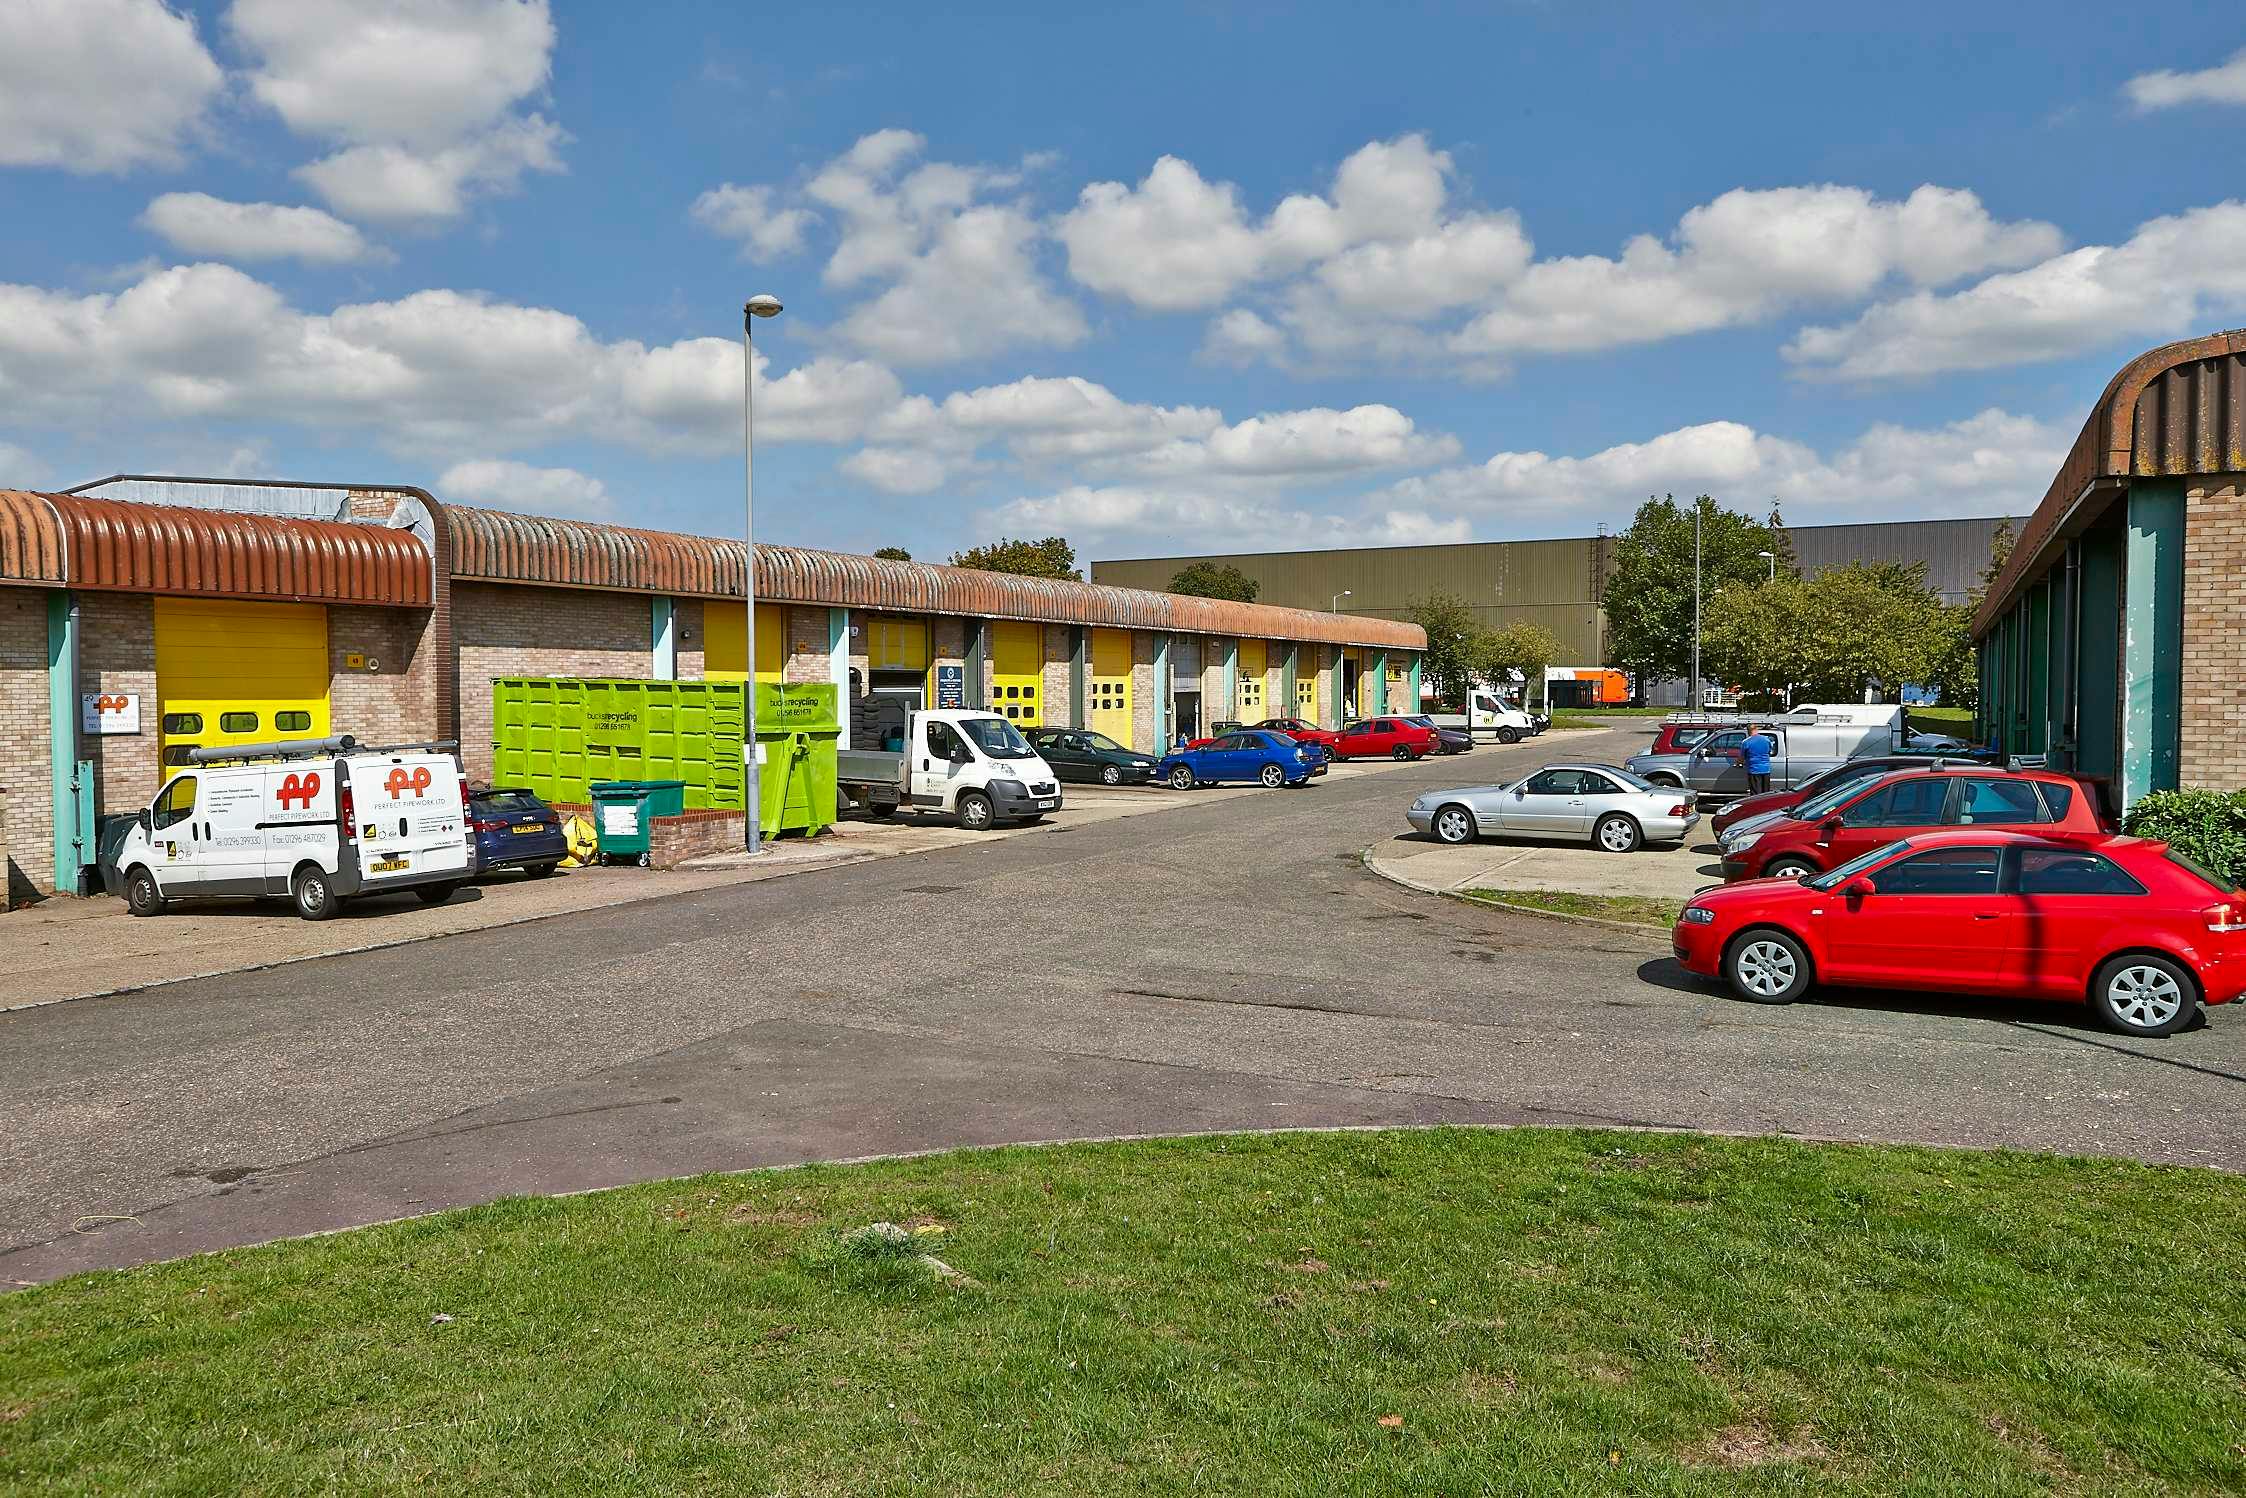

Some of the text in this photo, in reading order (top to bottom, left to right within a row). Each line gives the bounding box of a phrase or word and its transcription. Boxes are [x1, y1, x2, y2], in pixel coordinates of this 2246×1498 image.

[374, 801, 401, 810] PERFECT
[403, 799, 434, 808] PIPEWORK
[269, 813, 289, 821] PERFECT
[290, 812, 319, 820] PIPEWORK
[284, 834, 302, 844] 01296
[303, 833, 326, 842] 487029
